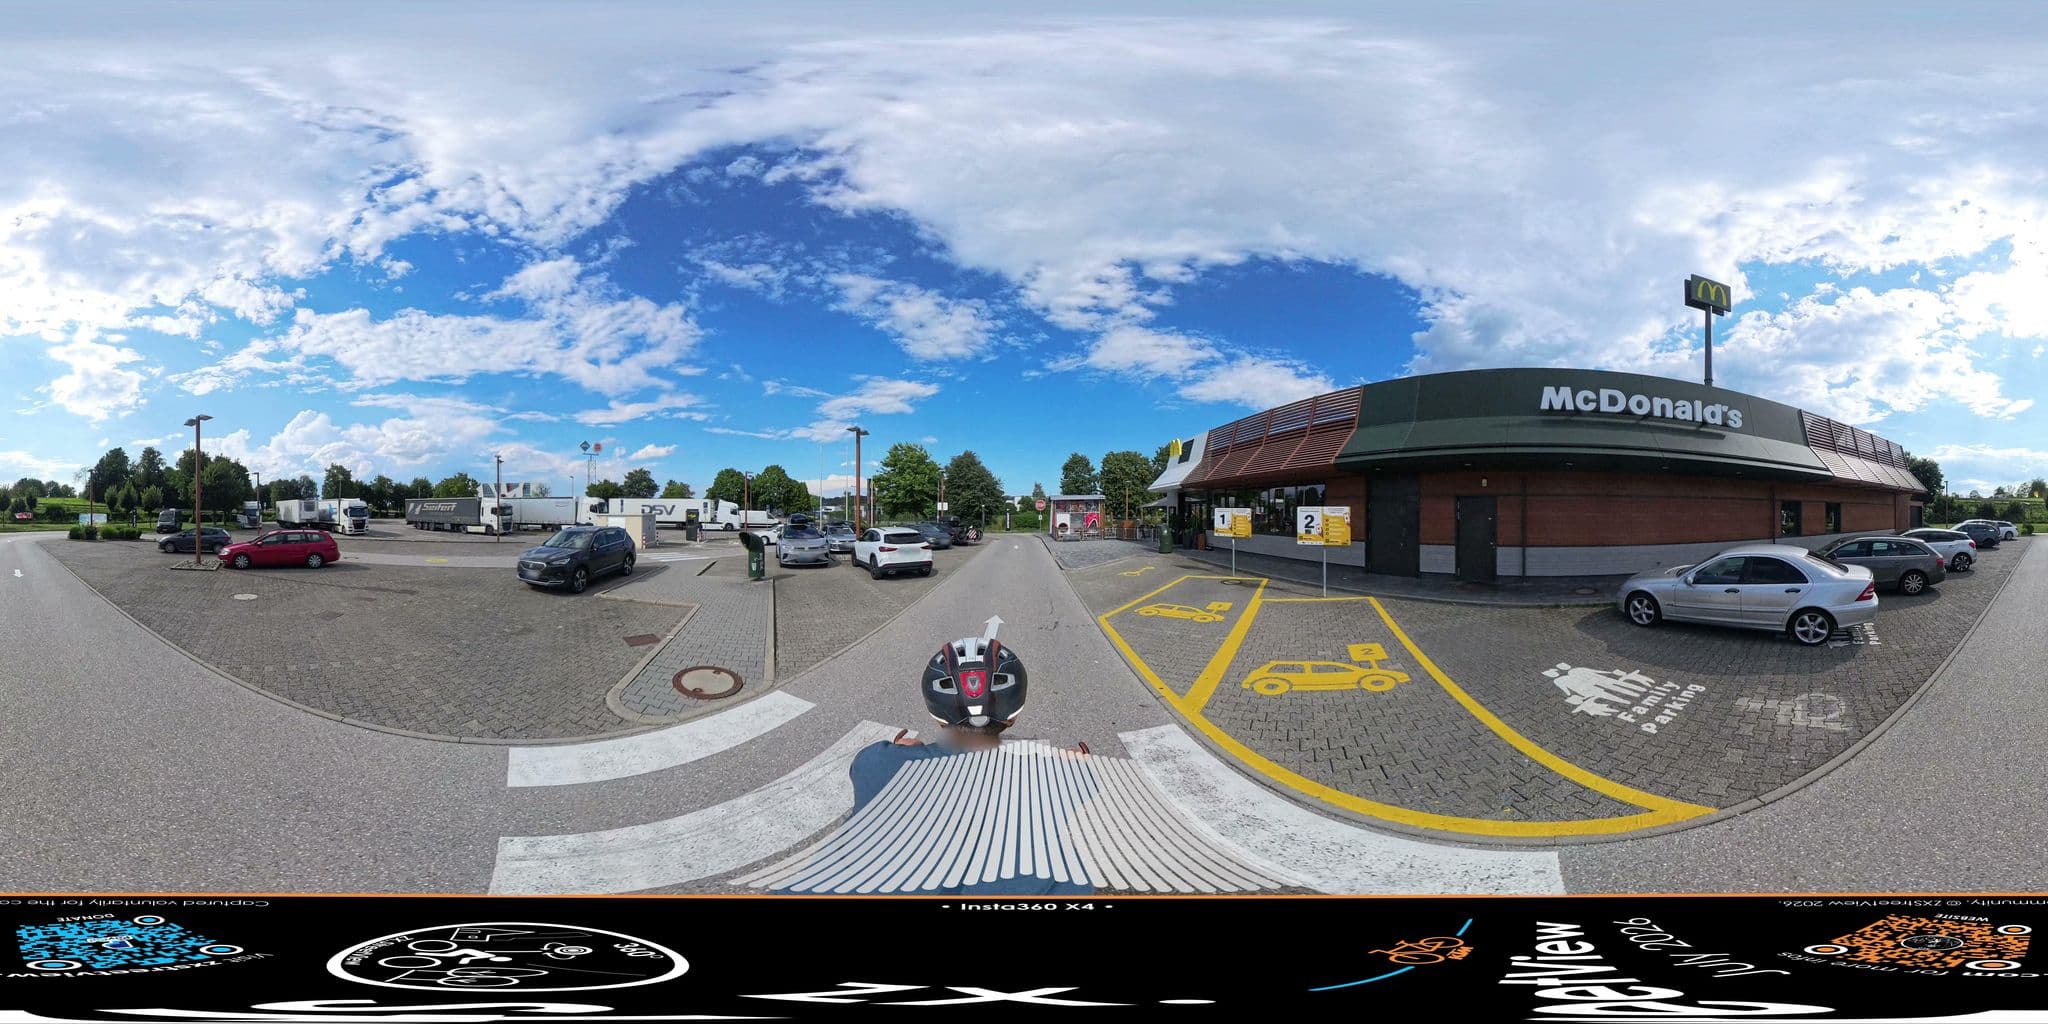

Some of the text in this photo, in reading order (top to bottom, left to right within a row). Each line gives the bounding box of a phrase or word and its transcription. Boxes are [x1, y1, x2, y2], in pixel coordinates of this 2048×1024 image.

[1539, 386, 1744, 429] McDonald's
[421, 502, 457, 511] Seifert
[641, 504, 676, 515] DSV
[1219, 514, 1226, 525] 1
[1304, 514, 1315, 529] 2
[1617, 681, 1681, 723] Family
